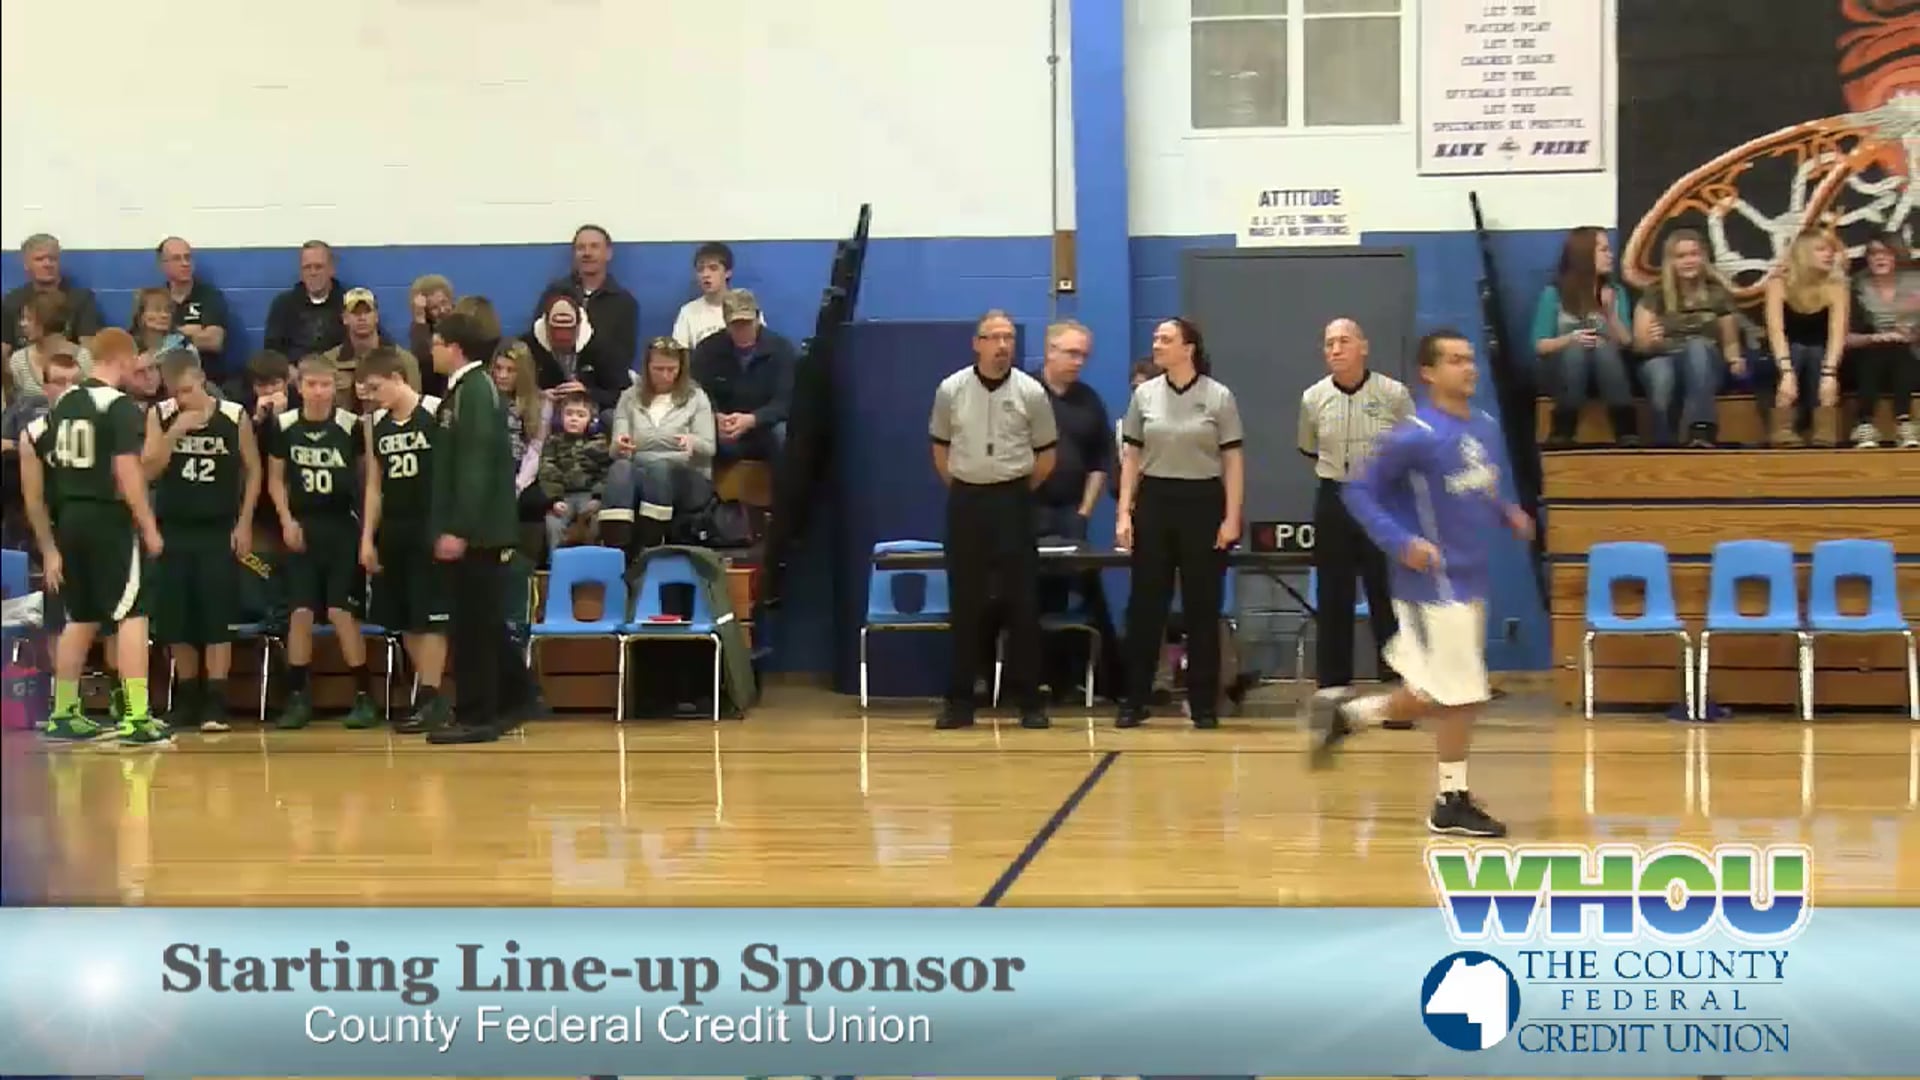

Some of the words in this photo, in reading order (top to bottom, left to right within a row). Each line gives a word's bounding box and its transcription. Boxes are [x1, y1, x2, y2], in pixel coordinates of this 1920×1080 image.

[1259, 189, 1342, 206] ATTITUDE
[49, 418, 96, 468] 40
[181, 457, 215, 482] 42
[388, 453, 419, 478] 20
[301, 469, 333, 493] 30
